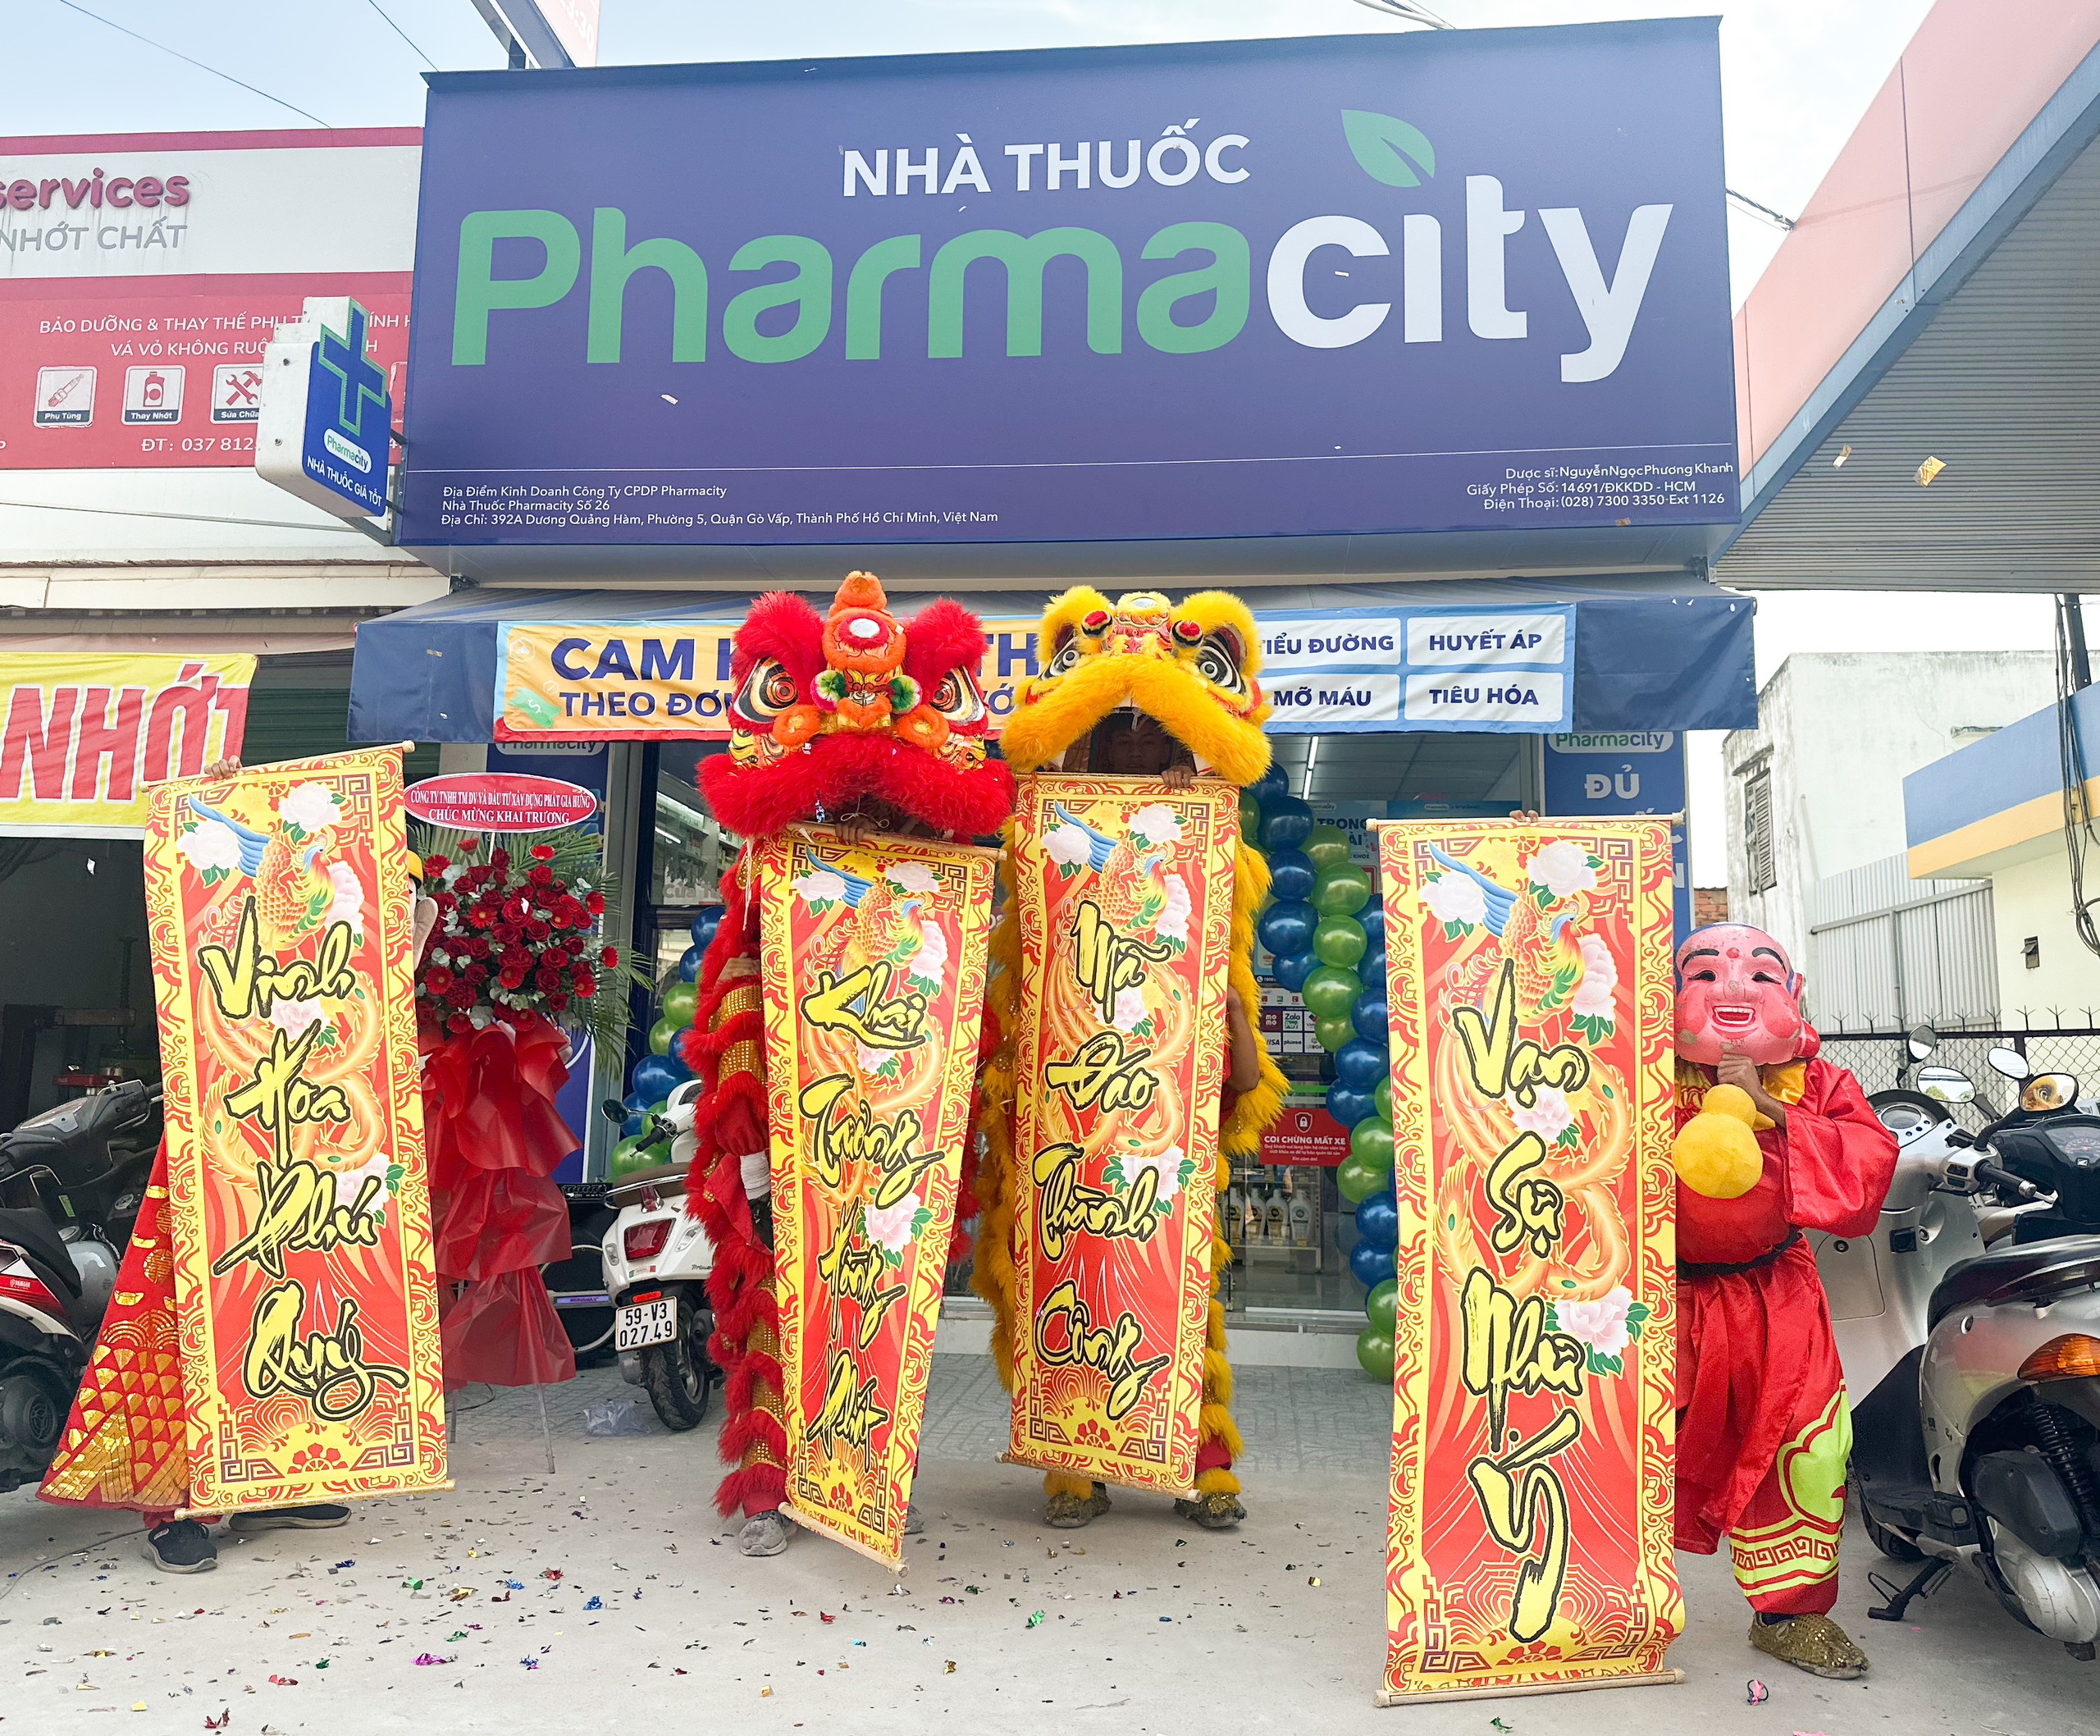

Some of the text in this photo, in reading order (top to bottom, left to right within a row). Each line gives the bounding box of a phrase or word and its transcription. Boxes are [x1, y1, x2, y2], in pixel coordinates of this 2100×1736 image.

[842, 118, 1251, 197] NHÀ THUỐC
[0, 167, 190, 210] ervices
[97, 216, 188, 249] CHẤT
[451, 174, 1674, 383] Pharmacity
[39, 316, 76, 334] BẢO
[80, 314, 142, 332] DƯỠNG
[147, 318, 159, 331] &
[163, 317, 208, 331] THAY
[212, 311, 247, 330] THẾ
[111, 340, 134, 356] VÁ
[139, 339, 162, 356] VỎ
[167, 338, 229, 356] KHÔNG
[44, 412, 82, 421] Phụ Tùng
[130, 411, 173, 421] Thay Nhớt
[181, 437, 216, 452] 037
[327, 435, 369, 471] Pharmacity
[307, 455, 382, 507] NHÀ THUỐC GIÁ TỐT
[1505, 468, 1541, 482] Dược
[1544, 466, 1559, 478] sĩ:
[1695, 462, 1733, 473] Khanh
[444, 485, 728, 500] Địa Điểm Kinh Doanh Công Ty CPDP Pharmacity
[1467, 482, 1496, 497] Giấy
[1500, 482, 1534, 496] Phép
[1538, 480, 1559, 493] Số:
[1664, 481, 1696, 491] HCM
[442, 499, 609, 514] Nhà Thuốc Pharmacity Số 26
[1484, 498, 1515, 511] Điện
[1519, 497, 1559, 510] Thoại:
[1561, 496, 1593, 508] (028)
[1597, 496, 1628, 506] 7300
[1694, 493, 1725, 504] 1126
[441, 514, 461, 528] Địa
[464, 513, 487, 525] Chỉ:
[491, 514, 523, 525] 392A
[526, 514, 566, 528] Dương
[569, 513, 610, 528] Quảng
[614, 514, 644, 527] Hàm,
[647, 513, 693, 527] Phường
[710, 514, 743, 528] Quận
[746, 513, 765, 523] Gò
[767, 511, 792, 526] Vấp,
[796, 512, 833, 523] Thành
[836, 510, 859, 523] Phố
[862, 510, 879, 523] Hồ
[883, 511, 903, 523] Chí
[906, 511, 940, 524] Minh,
[943, 511, 966, 524] Việt
[970, 512, 998, 523] Nam
[1260, 632, 1394, 655] IỂU ĐƯỜNG
[1429, 628, 1542, 651] HUYẾT ÁP
[551, 638, 695, 681] CAM
[559, 692, 656, 717] THEO
[1274, 686, 1372, 706] MỠ MÁU
[1429, 684, 1539, 706] TIÊU HÓA
[1585, 764, 1640, 799] ĐỦ
[411, 786, 429, 803] CÔNG
[430, 792, 439, 804] TY
[440, 791, 458, 804] TNHH
[458, 792, 468, 804] TM
[469, 793, 478, 805] DV
[478, 788, 487, 805] VÀ
[501, 791, 512, 806] TƯ
[512, 790, 525, 806] XÂY
[525, 793, 544, 810] DỰNG
[544, 790, 561, 807] PHÁT
[561, 795, 572, 808] GIA
[428, 805, 570, 825] CHÚC MỪNG KHAI TRƯƠNG
[198, 896, 355, 1019] Vinh
[801, 961, 927, 1049] Khai
[1452, 958, 1589, 1108] Vạn
[223, 1019, 350, 1169] Hoa
[1314, 1135, 1334, 1144] MẤT
[213, 1160, 381, 1278] Phú
[625, 1302, 668, 1327] 59-V3
[619, 1321, 673, 1347] 027.49
[245, 1280, 410, 1421] Quý
